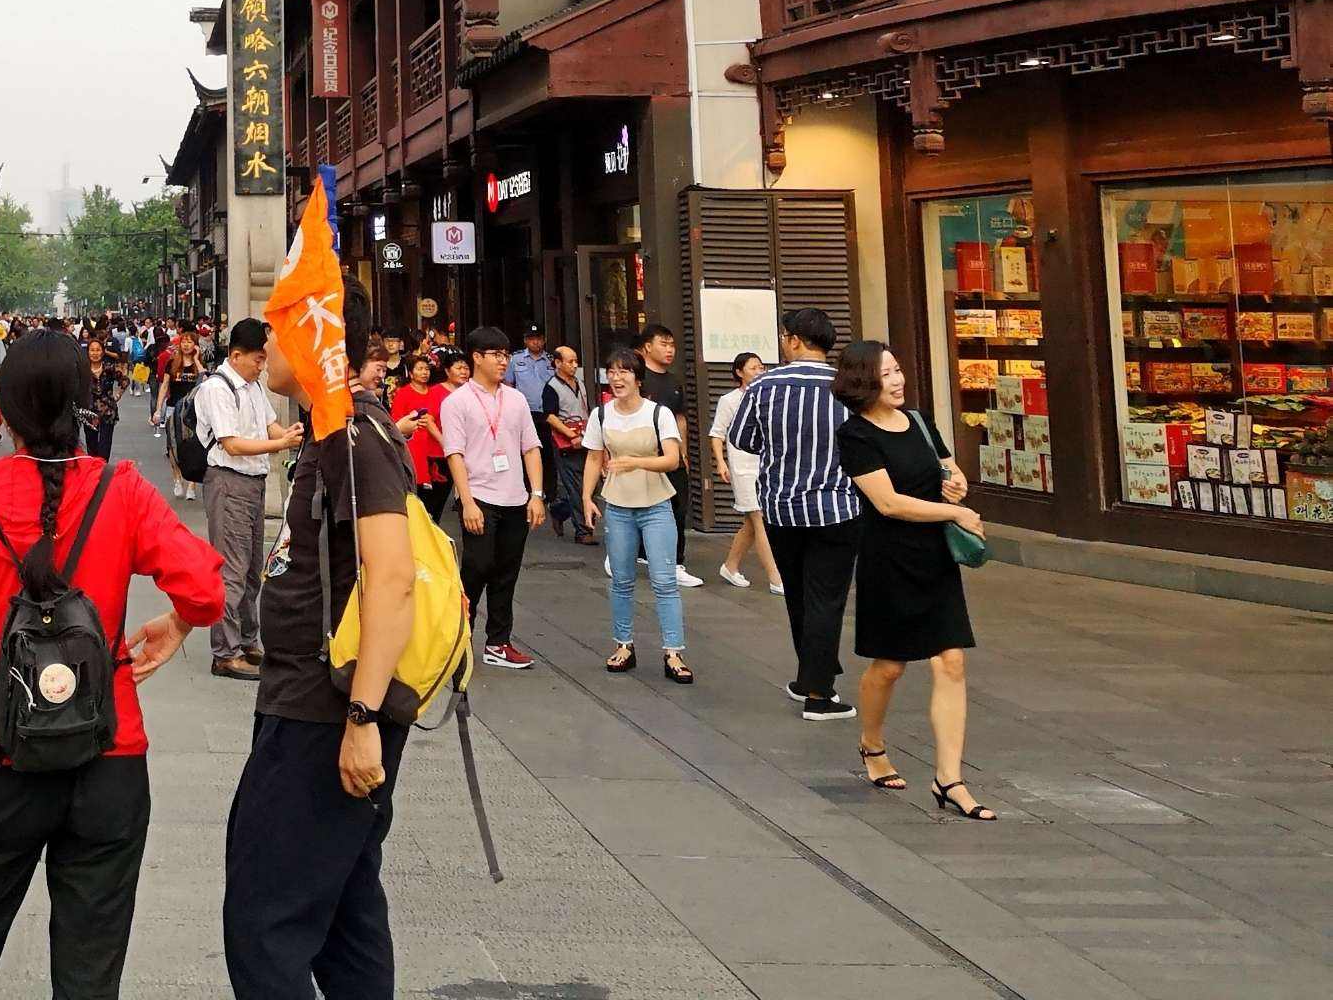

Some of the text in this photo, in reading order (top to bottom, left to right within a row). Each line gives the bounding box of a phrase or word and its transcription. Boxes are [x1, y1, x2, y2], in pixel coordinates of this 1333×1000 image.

[323, 27, 339, 93] 纪念日百货
